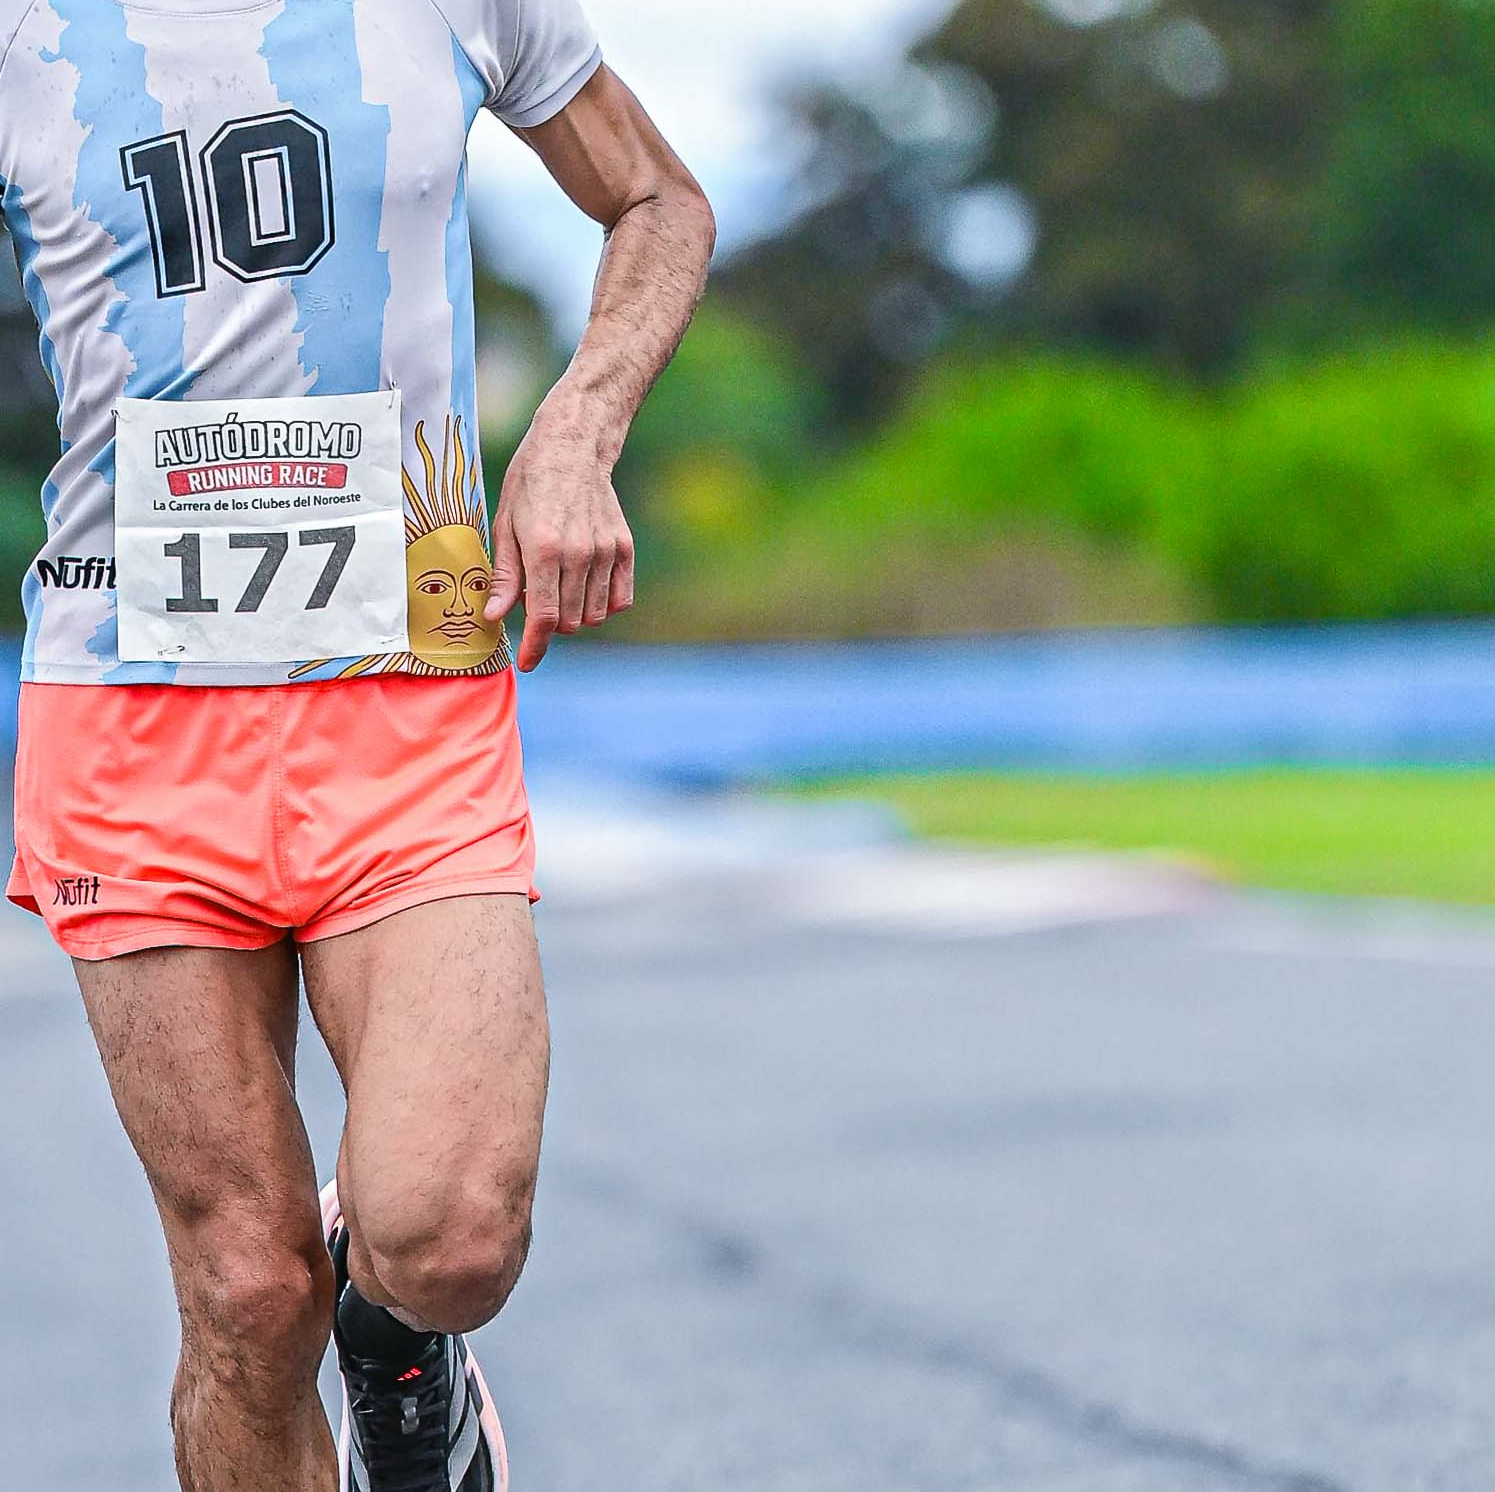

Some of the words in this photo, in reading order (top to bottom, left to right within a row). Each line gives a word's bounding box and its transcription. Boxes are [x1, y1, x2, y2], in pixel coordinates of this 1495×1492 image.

[119, 108, 336, 299] 10
[154, 412, 361, 468] AUTÓDROMO
[153, 499, 166, 511] La
[168, 500, 211, 511] Carrera
[214, 499, 229, 511] de
[232, 498, 249, 510] los
[251, 497, 291, 509] Clubes
[293, 495, 311, 508] del
[313, 493, 361, 506] Noroeste
[187, 465, 273, 492] RUNNING
[279, 465, 329, 487] RACE
[164, 525, 355, 612] 177
